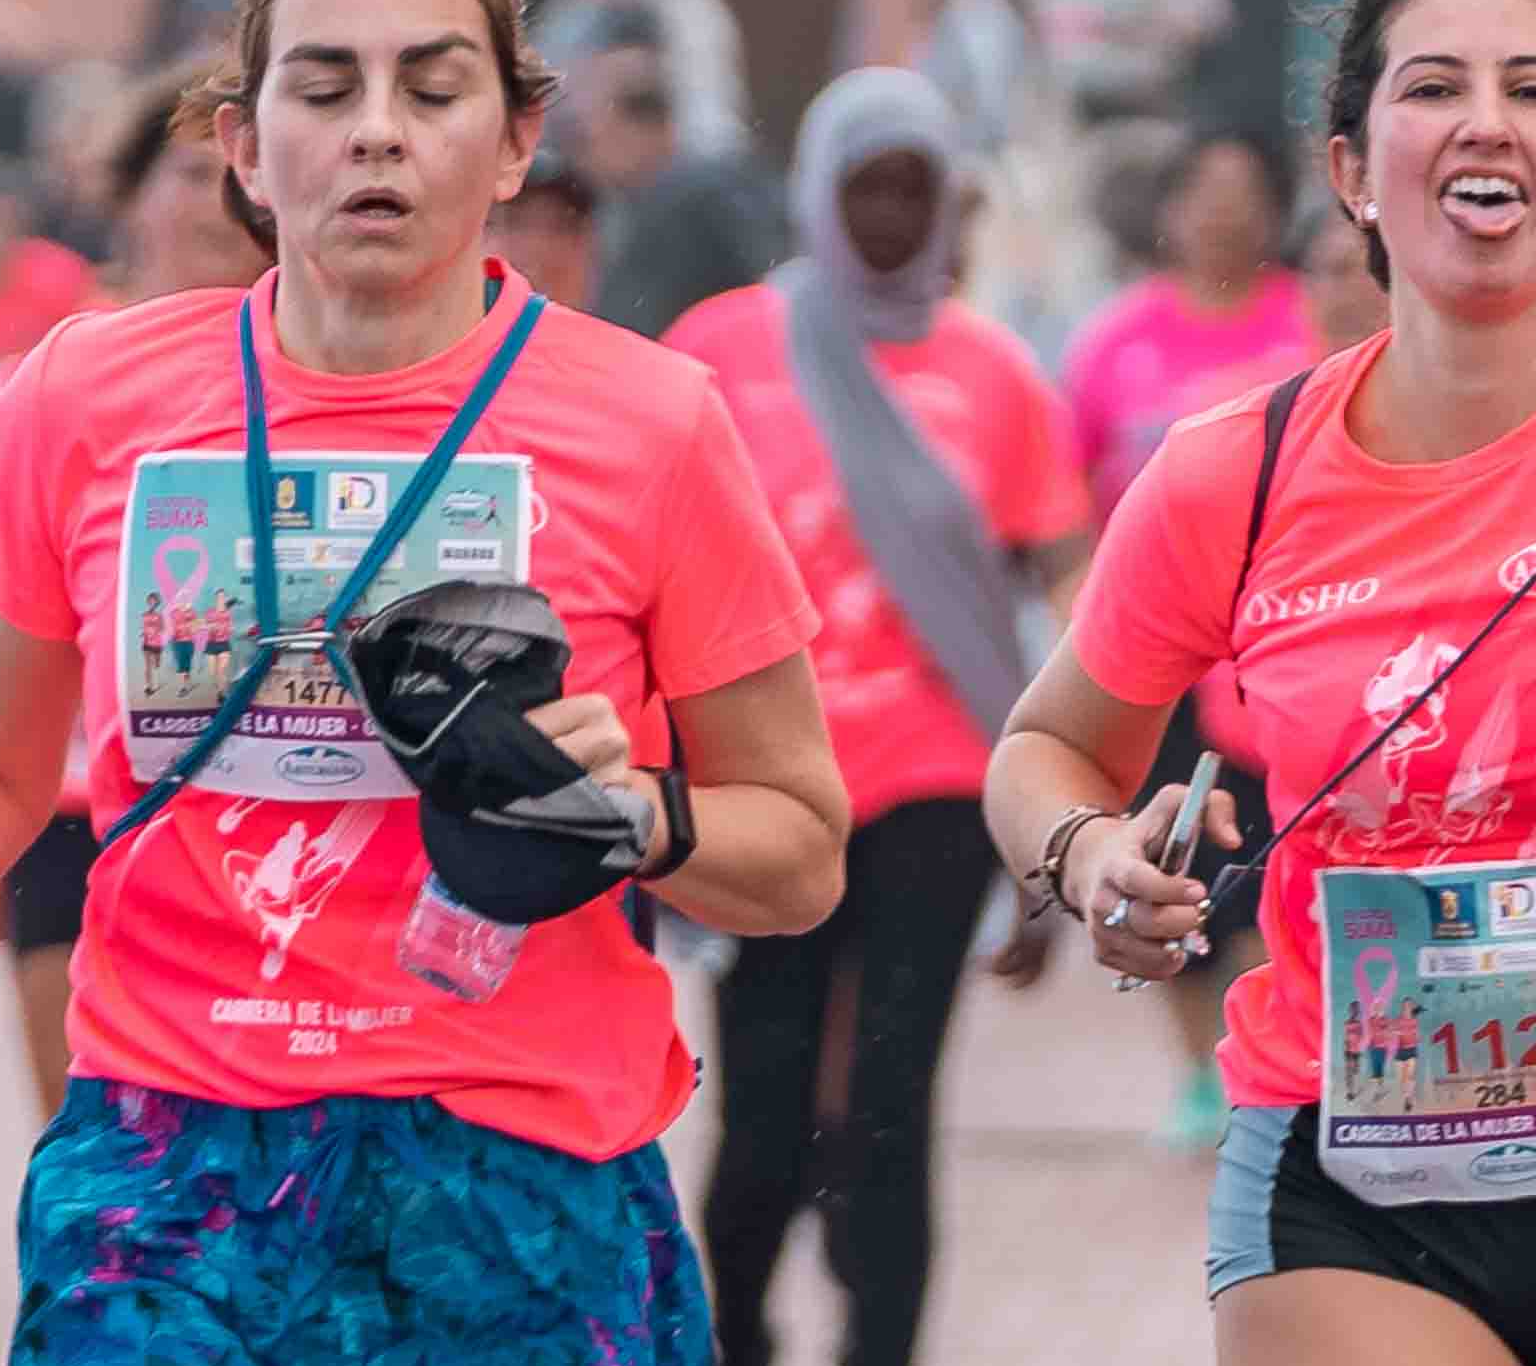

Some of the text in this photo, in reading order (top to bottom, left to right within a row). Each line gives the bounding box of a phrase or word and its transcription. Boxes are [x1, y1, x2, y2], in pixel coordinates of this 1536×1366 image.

[1245, 577, 1380, 626] OYSHO
[284, 680, 346, 705] 1477
[139, 715, 213, 734] CARRER
[254, 715, 279, 733] LA
[282, 715, 348, 736] MUJER
[210, 998, 292, 1024] CARRERA
[296, 1001, 323, 1025] DE
[345, 1005, 413, 1032] MUJER
[287, 1029, 338, 1056] 2024
[1474, 1083, 1527, 1109] 284
[1335, 1121, 1413, 1144] CARRERA
[1416, 1120, 1440, 1142] DE
[1443, 1119, 1466, 1139] LA
[1469, 1114, 1536, 1138] MUJER
